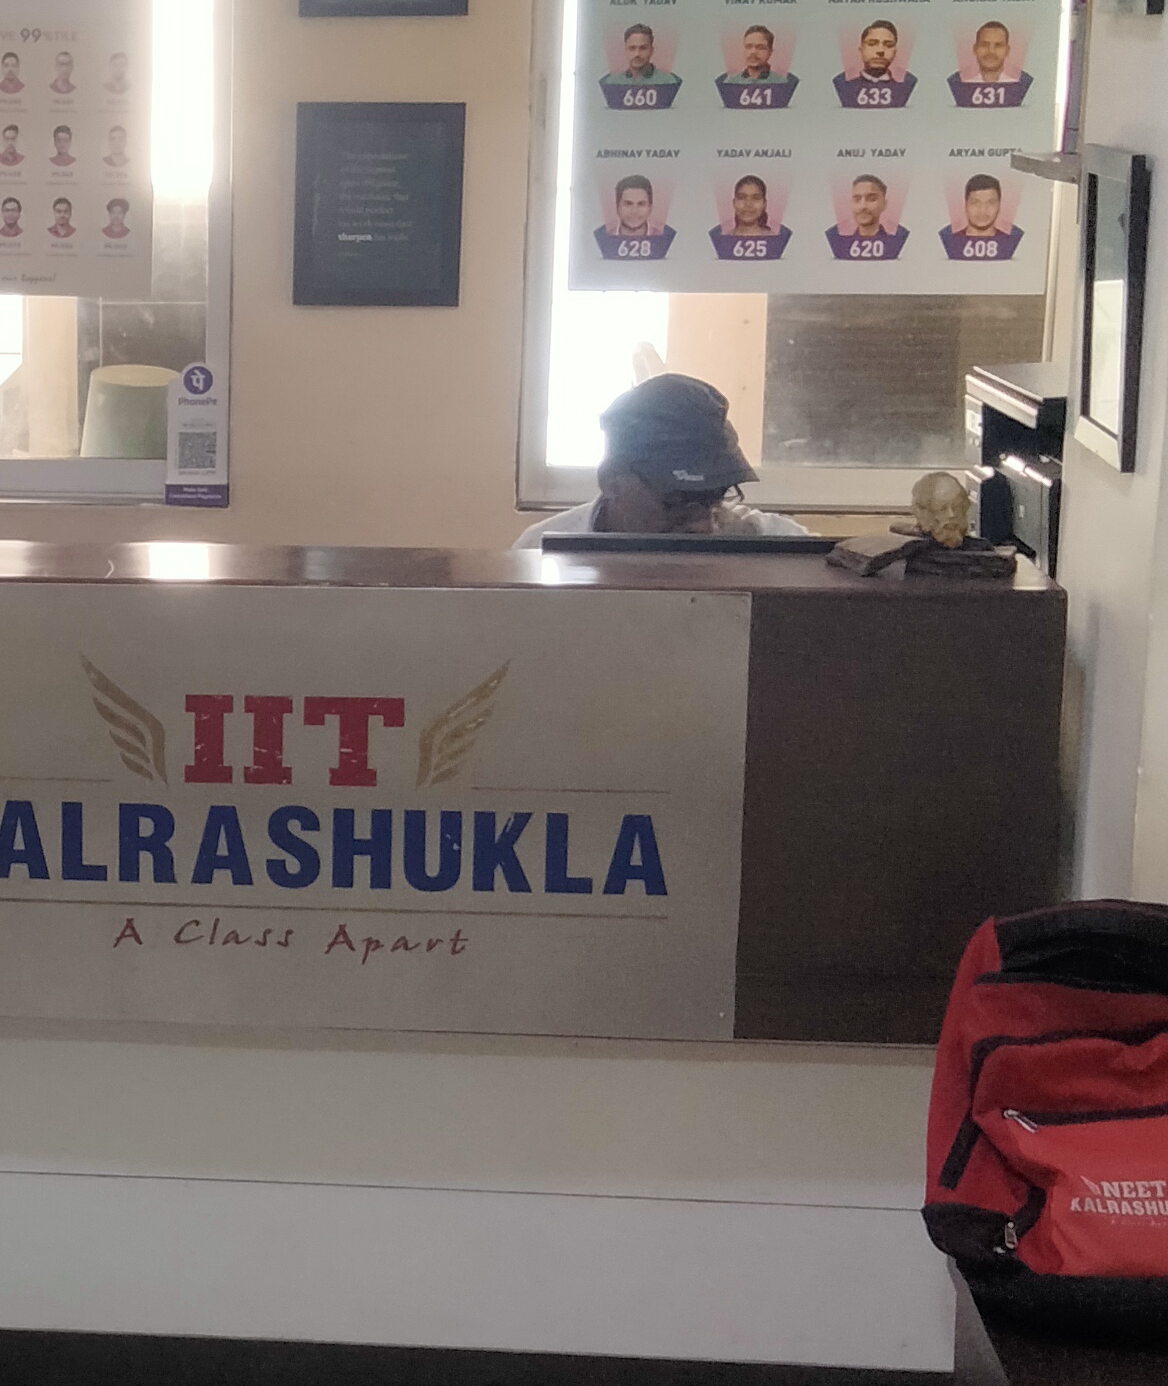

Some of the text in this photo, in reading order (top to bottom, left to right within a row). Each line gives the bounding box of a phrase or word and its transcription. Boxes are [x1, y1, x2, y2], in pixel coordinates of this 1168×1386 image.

[623, 88, 657, 106] 660
[739, 88, 773, 106] 641
[857, 87, 892, 105] 633
[971, 87, 1006, 104] 631
[646, 148, 681, 158] YADAV
[716, 149, 792, 158] YADAV ANJALI
[836, 148, 907, 158] ANUJ YADAV
[948, 148, 985, 158] ARYAN
[617, 240, 652, 257] 628
[733, 240, 767, 257] 625
[849, 240, 884, 257] 620
[962, 240, 998, 257] 608
[183, 693, 406, 787] IIT
[111, 917, 471, 963] A Class Apart
[1100, 1181, 1167, 1198] NEET
